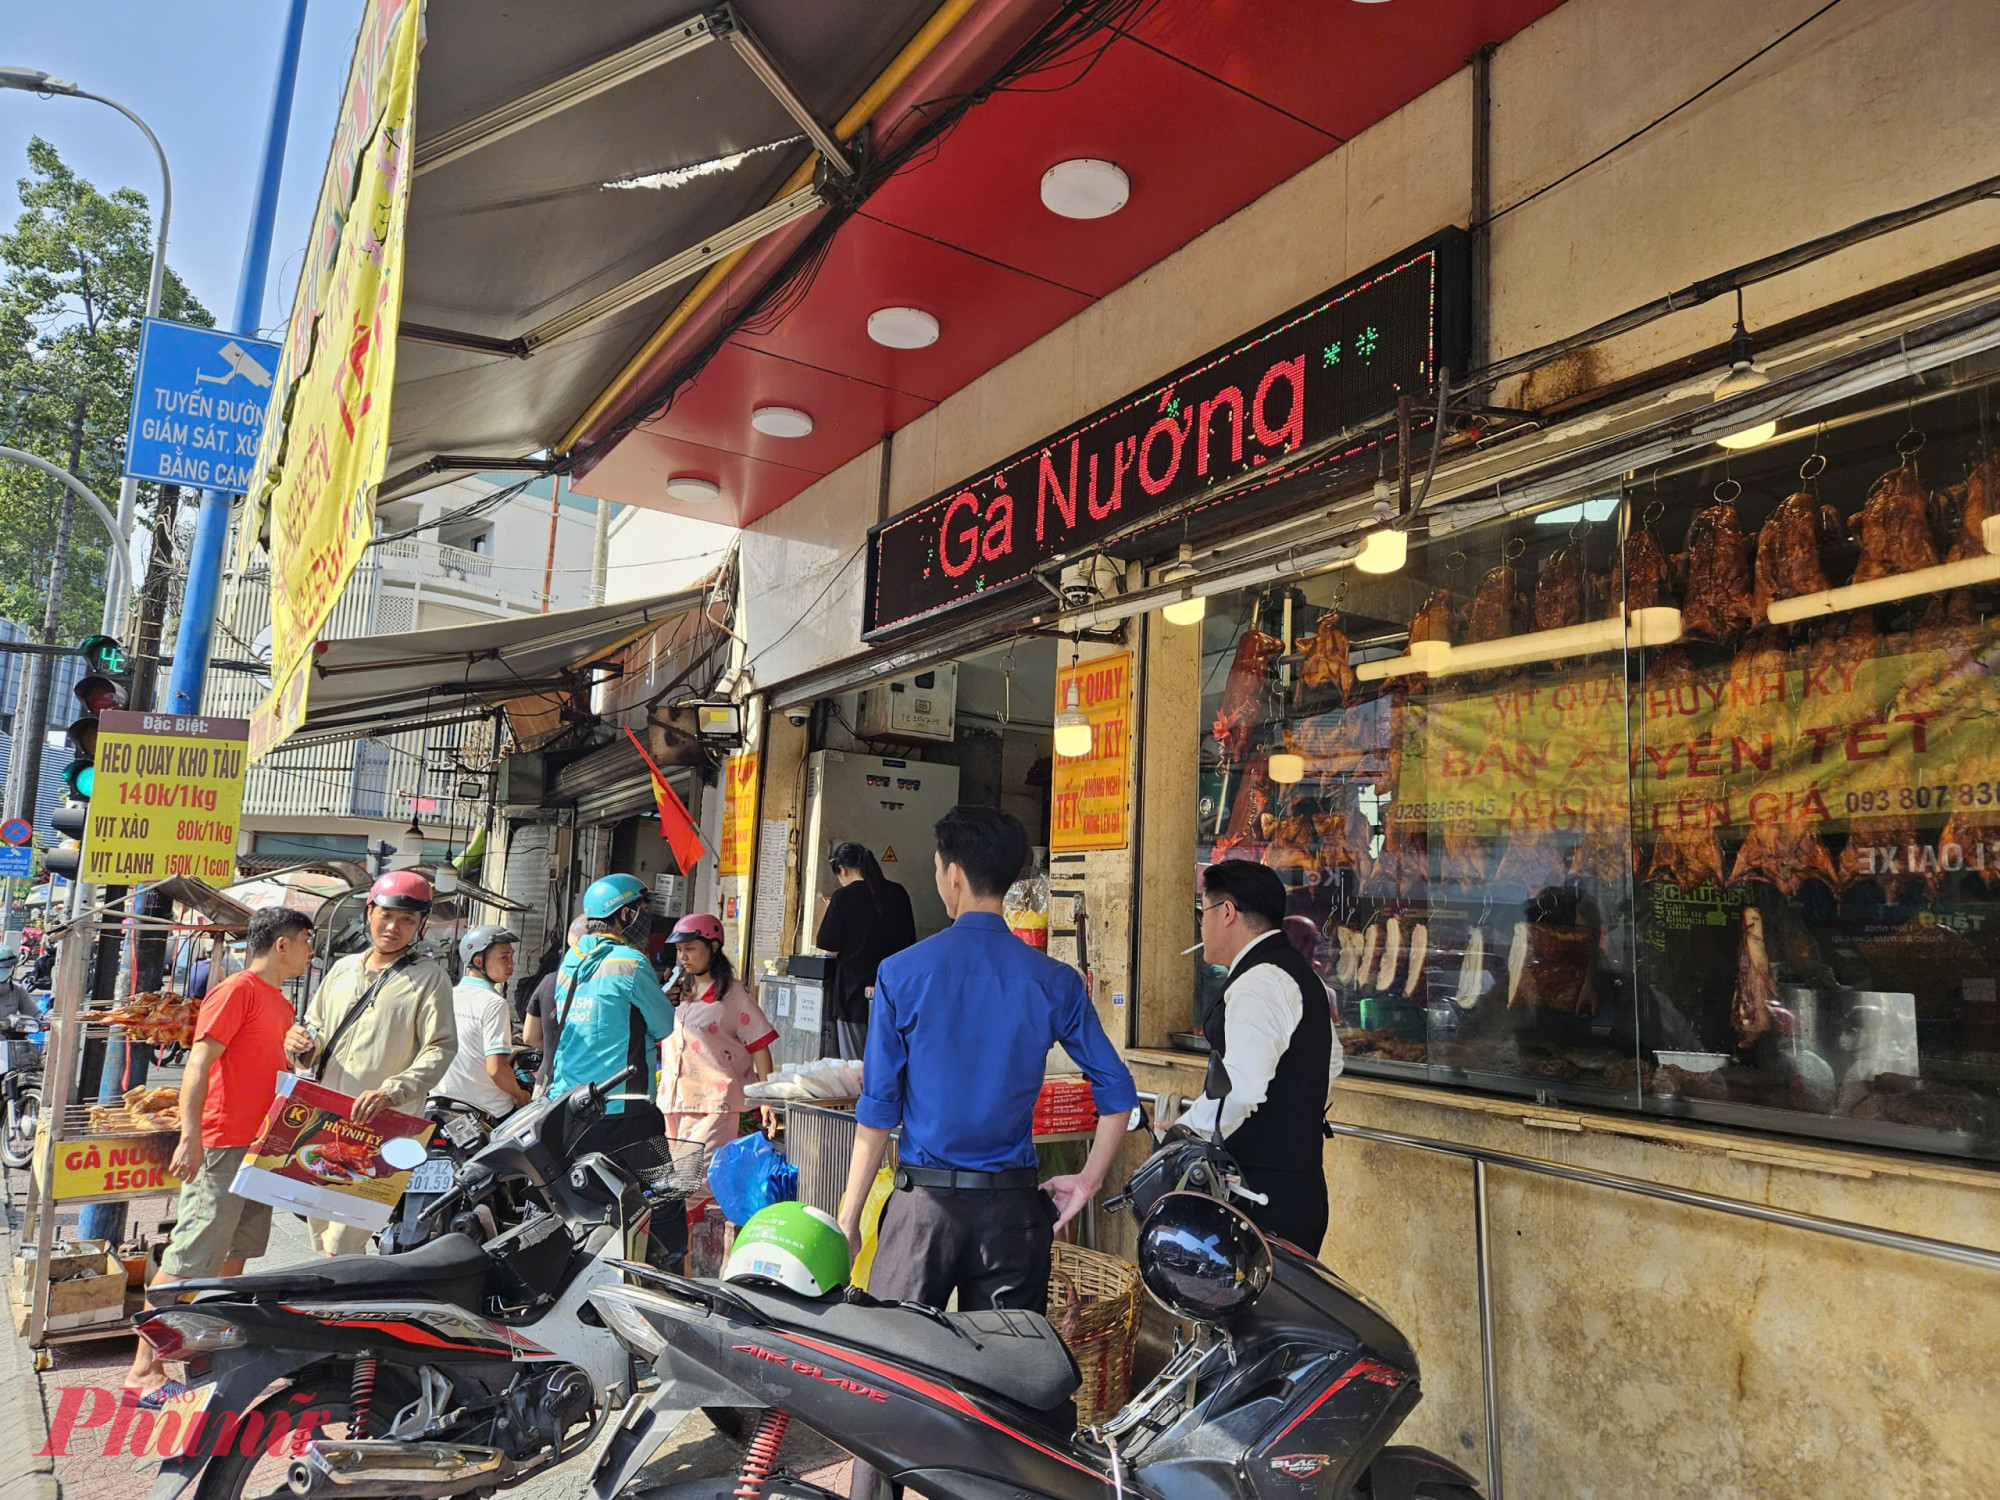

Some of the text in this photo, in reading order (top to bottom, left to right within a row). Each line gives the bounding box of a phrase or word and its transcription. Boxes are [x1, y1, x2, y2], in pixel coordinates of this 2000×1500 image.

[154, 387, 213, 418] TUYẾN
[142, 416, 189, 446] GIÁM
[158, 446, 210, 482] BẰNG
[939, 354, 1306, 578] Gà Nướng
[1085, 666, 1123, 706] QUAY
[143, 716, 208, 735] Đặc Biệt:
[1103, 707, 1123, 759] KÝ
[101, 743, 241, 779] HEO QUAY KHO TÀU
[1057, 777, 1078, 829] TẾT
[1084, 772, 1105, 798] KHÔNG
[1747, 780, 1832, 827] GIÁ
[1846, 789, 1890, 813] 093
[1900, 785, 1948, 810] 807
[95, 816, 117, 842] VỊT
[119, 813, 149, 839] XÀO
[91, 851, 112, 878] VỊT
[116, 854, 154, 879] LẠNH
[65, 1144, 101, 1171] GÀ
[102, 1167, 165, 1191] 150K
[731, 1344, 892, 1405] AIR BLADE
[1270, 1457, 1331, 1469] BLACK
